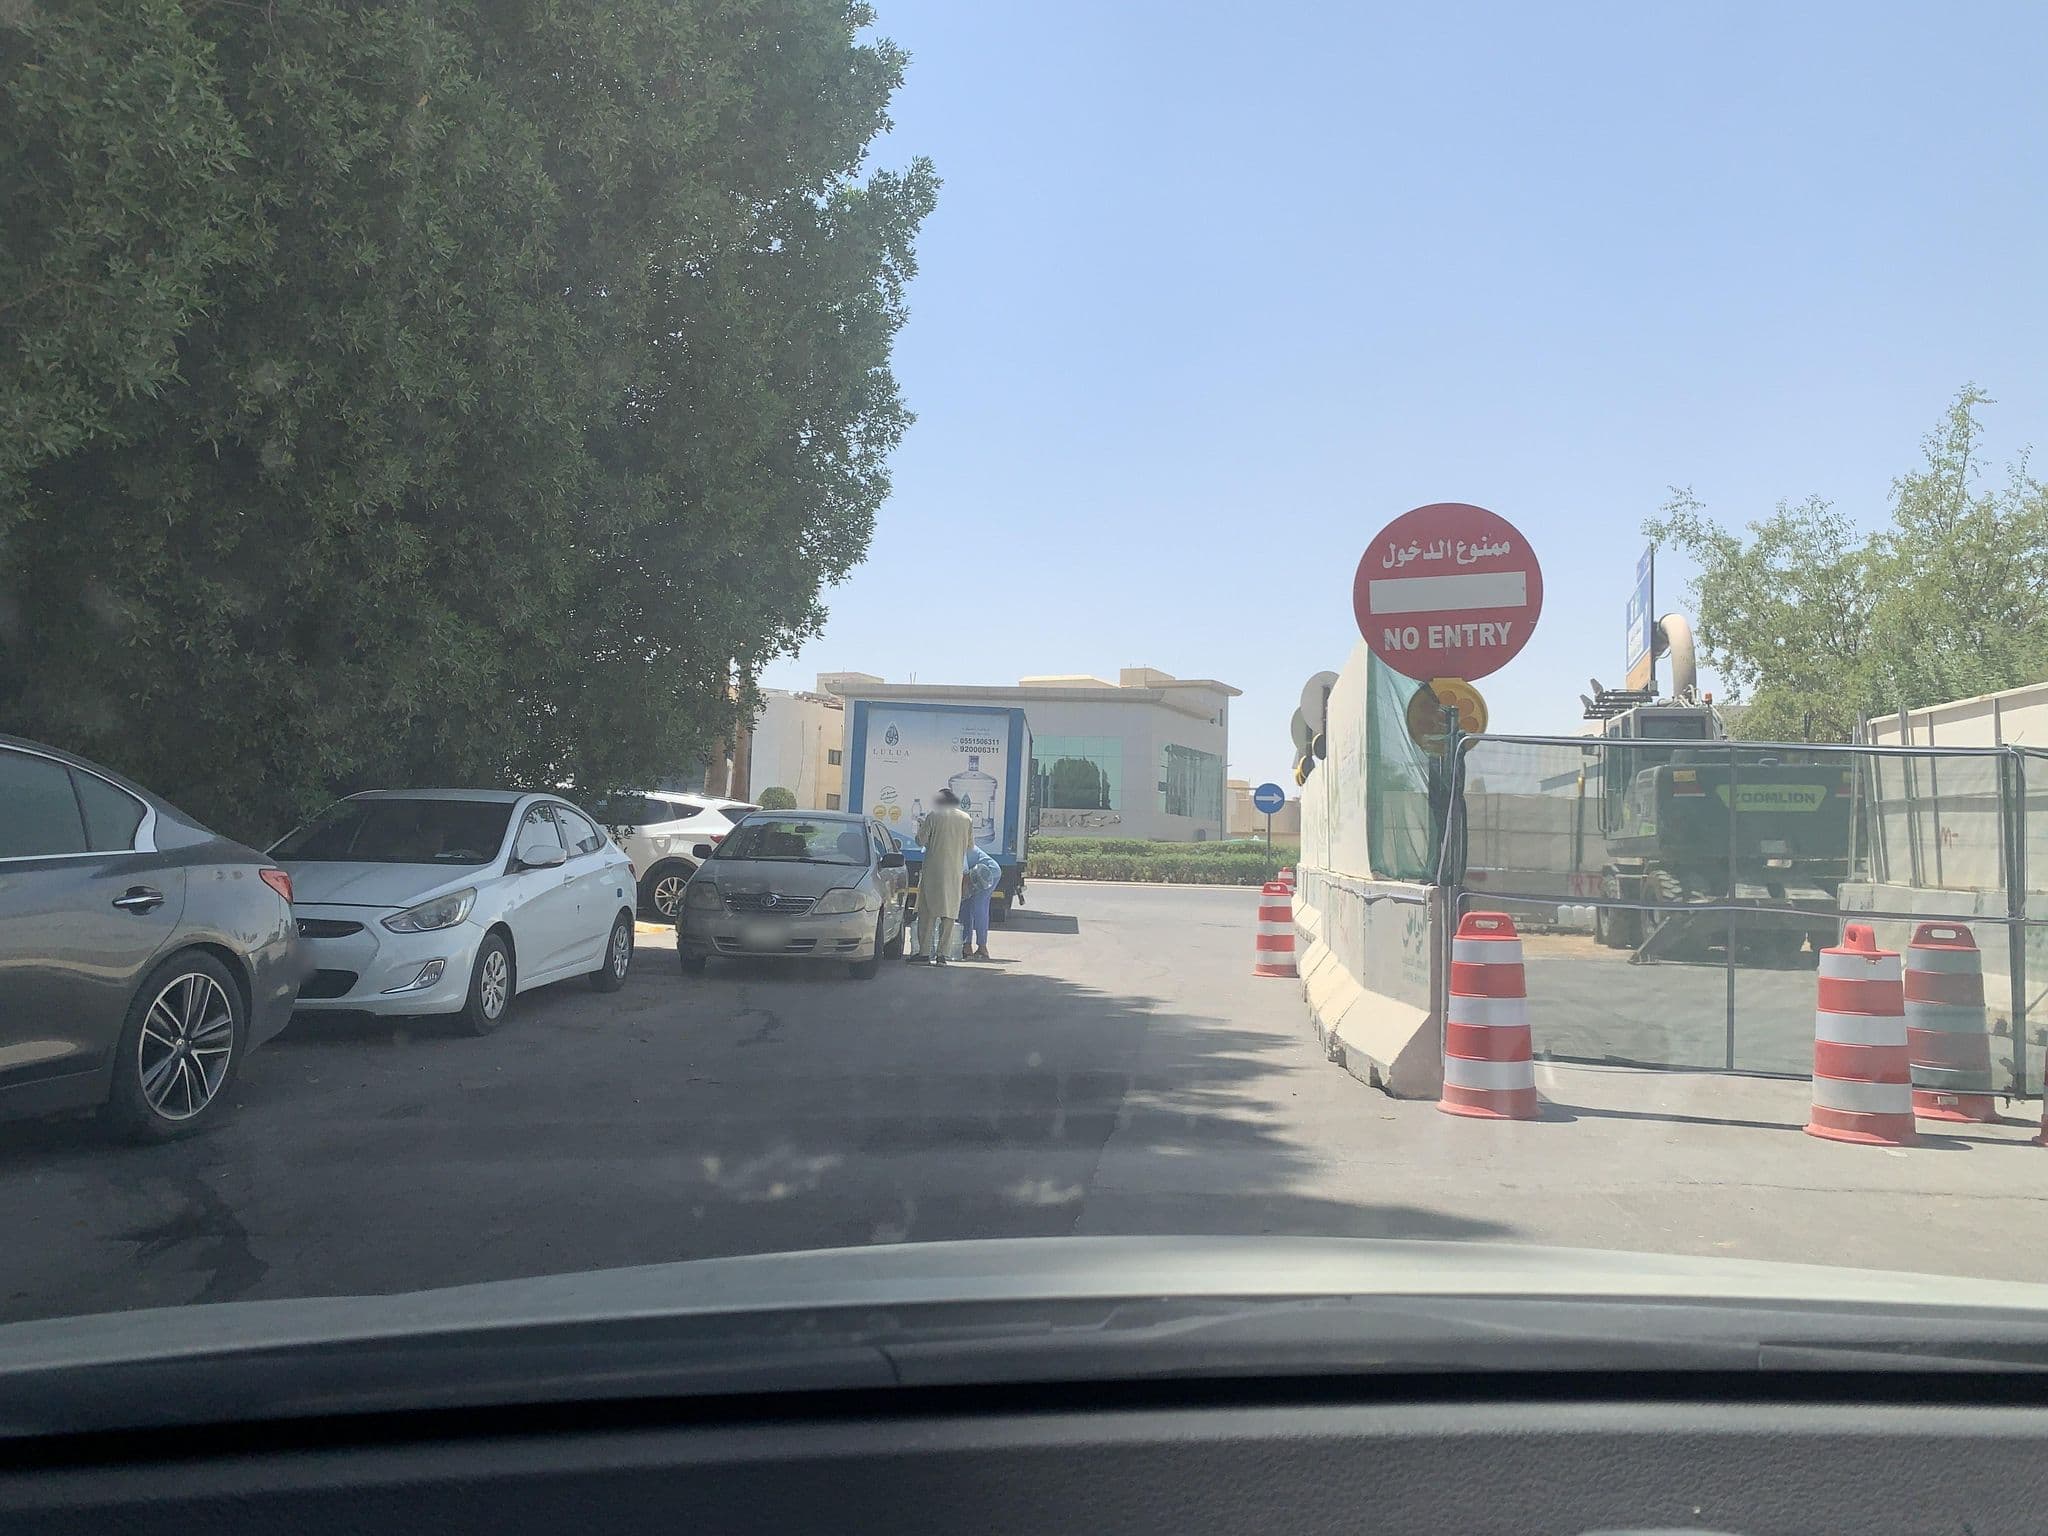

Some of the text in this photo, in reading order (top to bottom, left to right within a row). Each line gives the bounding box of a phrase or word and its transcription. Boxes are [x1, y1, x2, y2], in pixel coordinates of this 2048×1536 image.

[1382, 534, 1511, 569] ممنوع الدخول
[1384, 621, 1513, 651] NO ENTRY
[873, 748, 910, 757] LULUA
